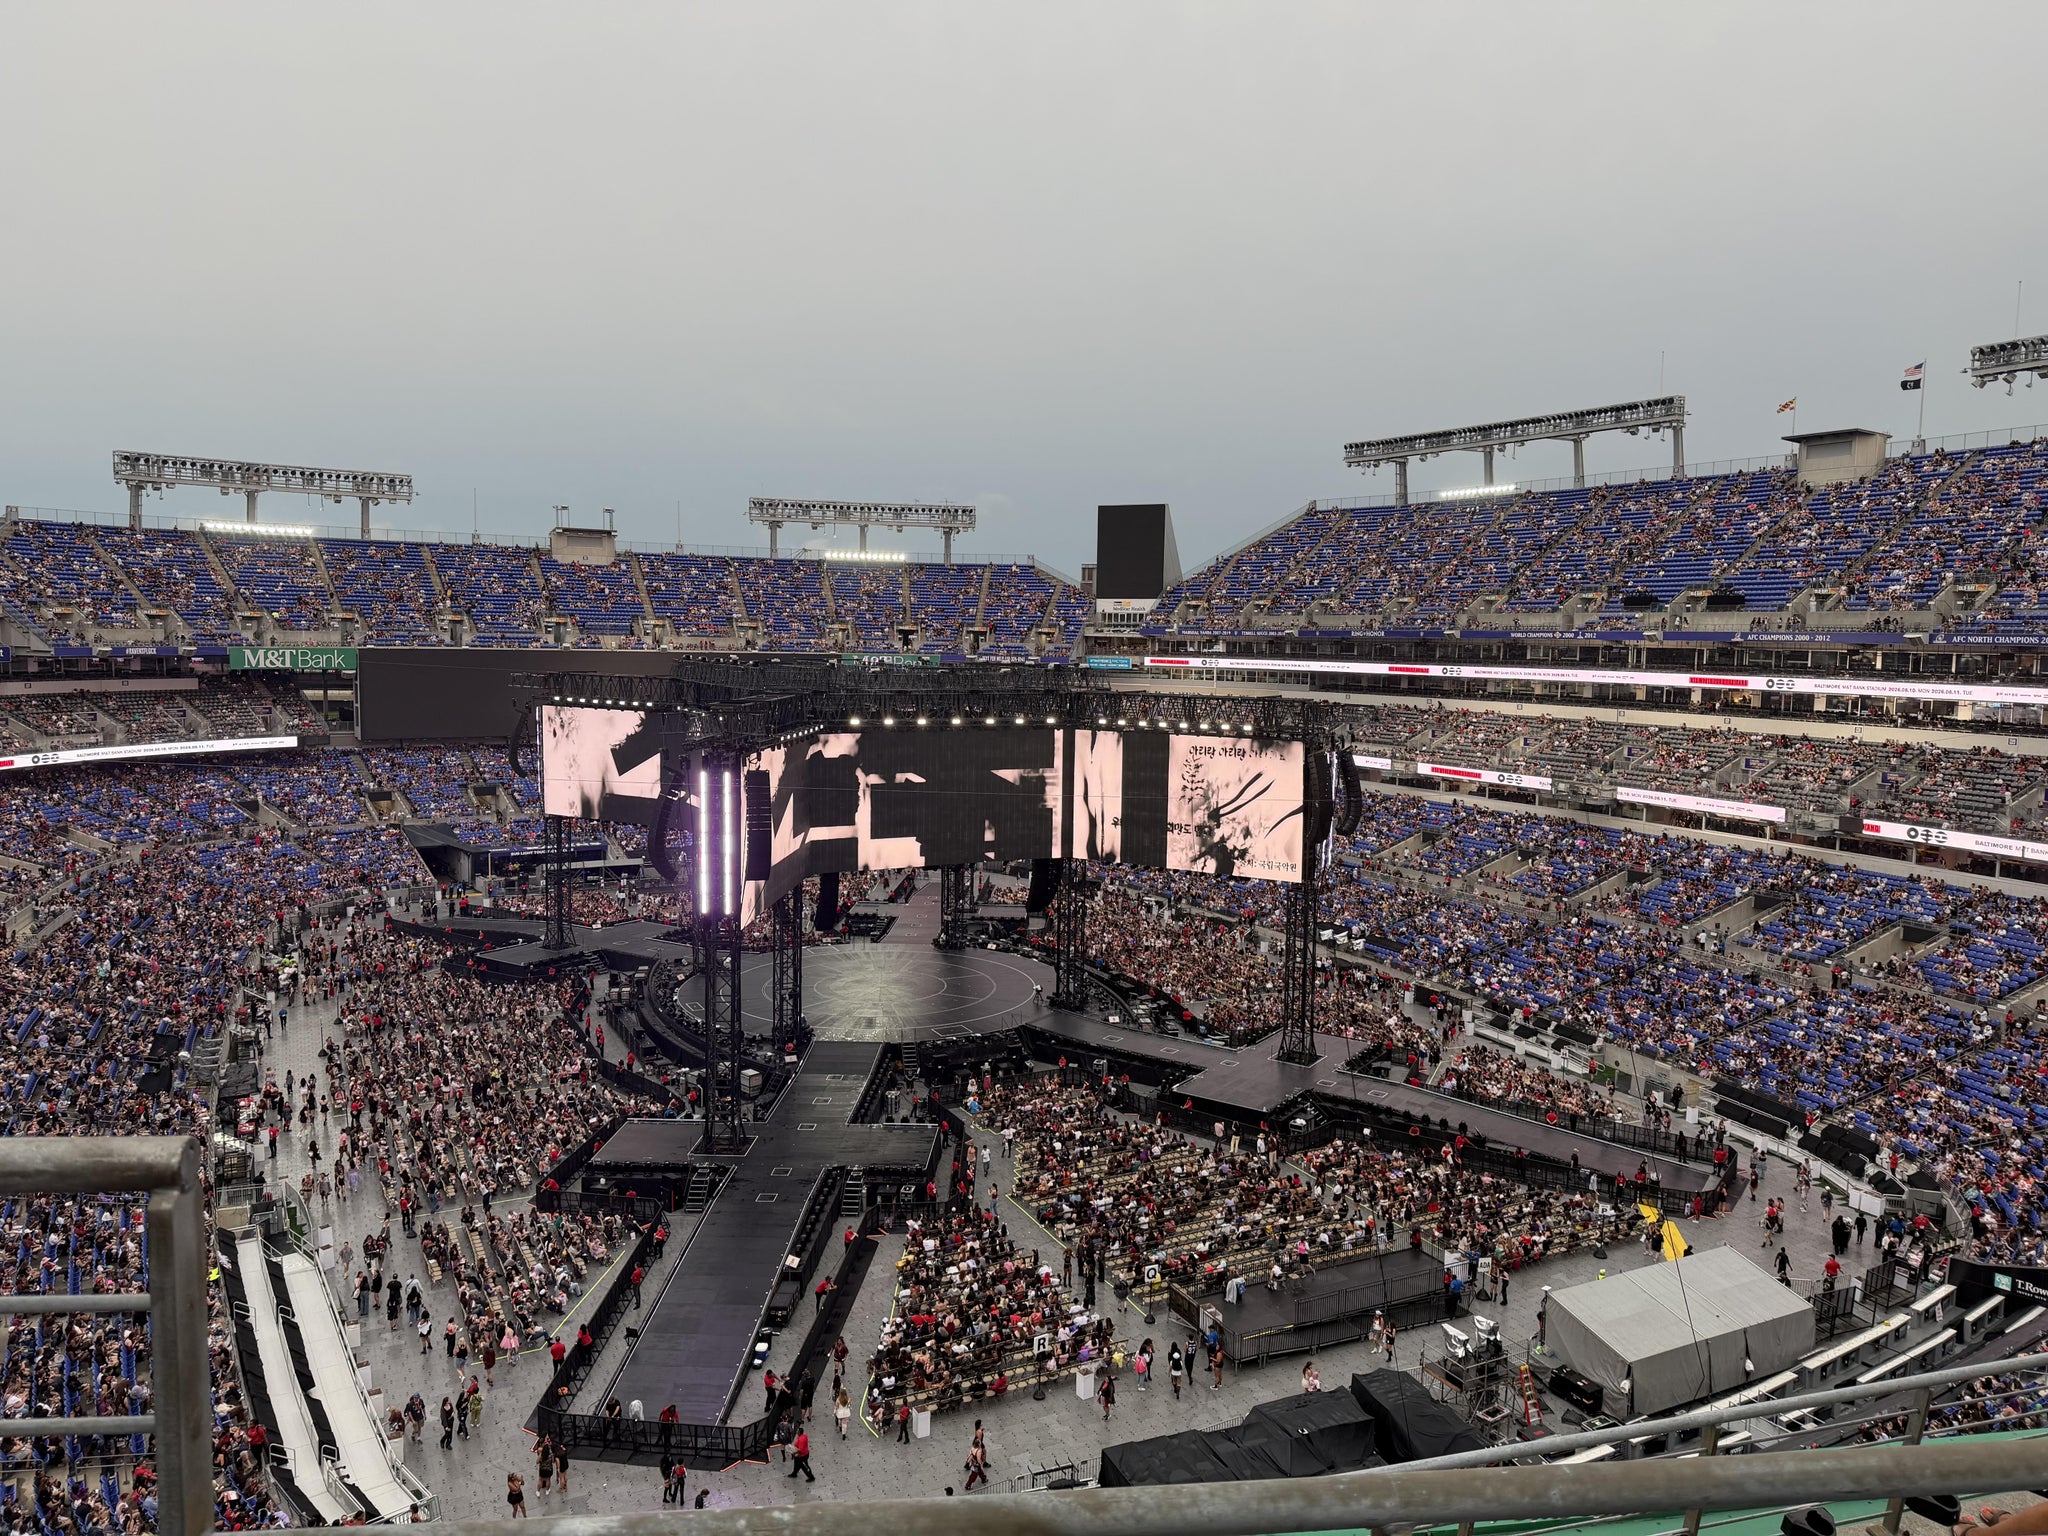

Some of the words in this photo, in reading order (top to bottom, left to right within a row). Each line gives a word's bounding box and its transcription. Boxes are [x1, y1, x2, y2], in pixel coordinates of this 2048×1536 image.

[243, 649, 295, 668] M&T
[298, 650, 346, 668] Bank
[1189, 745, 1216, 759] 아리랑
[1219, 746, 1246, 761] 아리랑
[1975, 840, 2013, 851] BALTIMORE
[1146, 1267, 1157, 1279] Q
[1037, 1337, 1046, 1348] R
